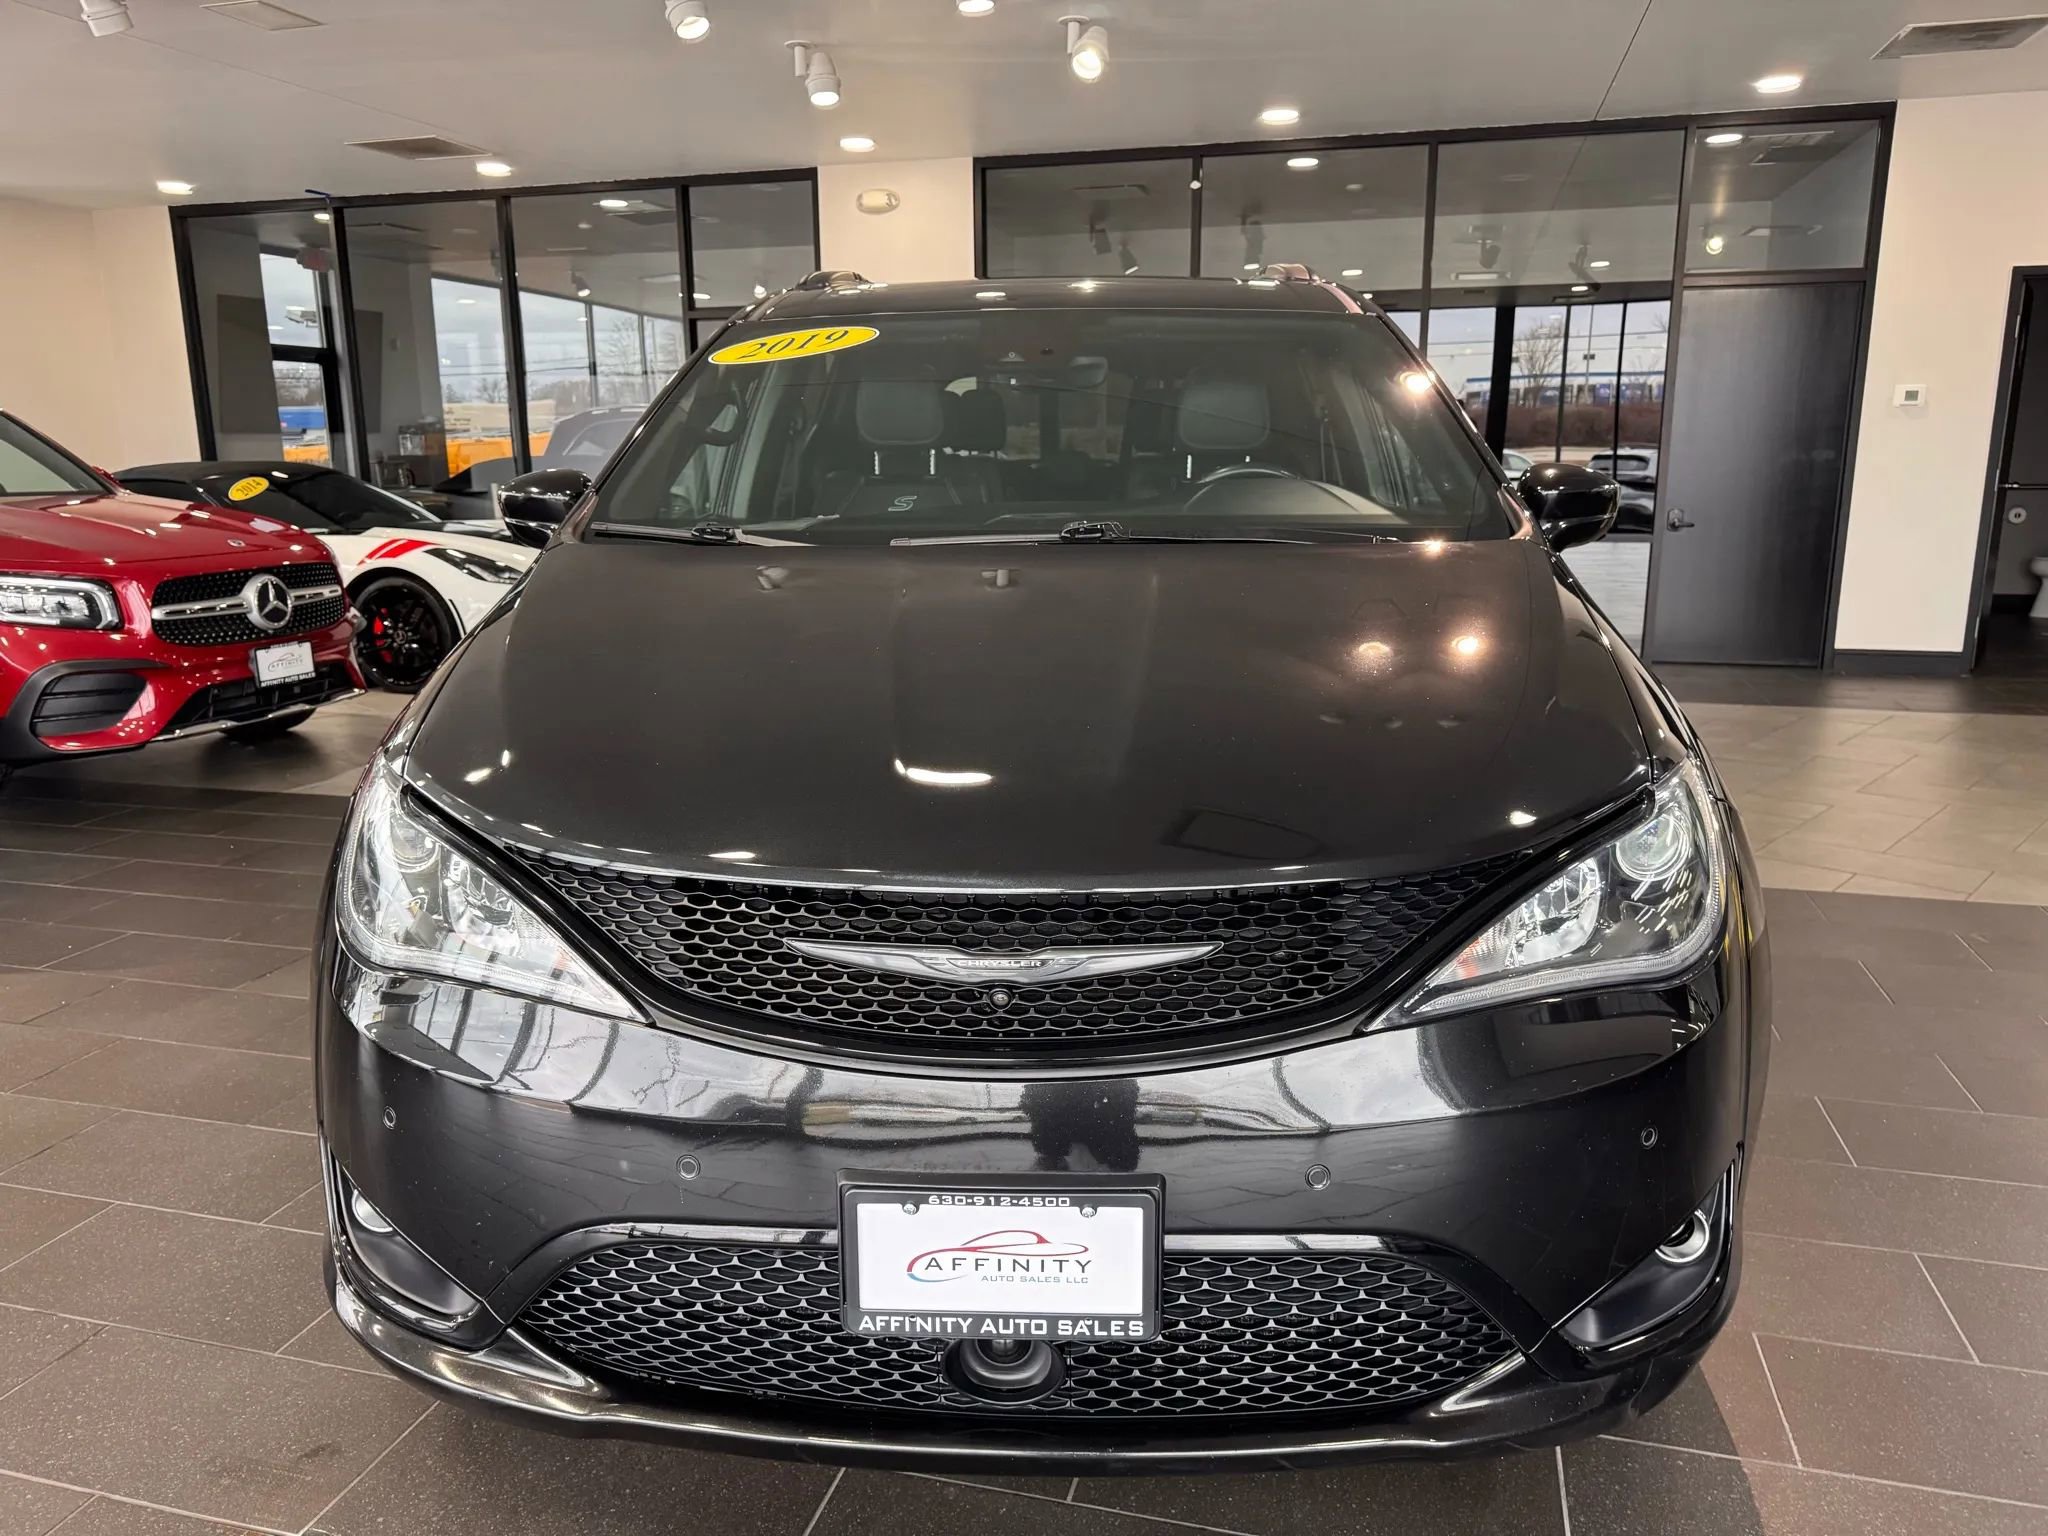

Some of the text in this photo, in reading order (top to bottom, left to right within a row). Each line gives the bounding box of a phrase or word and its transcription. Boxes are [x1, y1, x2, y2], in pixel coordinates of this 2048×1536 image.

[737, 330, 849, 359] 2019
[957, 959, 1042, 967] CHRYSLER
[928, 1195, 1070, 1207] 630-912-4500
[925, 1257, 1092, 1273] AFFINITY
[1066, 1276, 1088, 1284] LLC
[859, 1315, 1144, 1336] AFFINITY AUTO SALES
